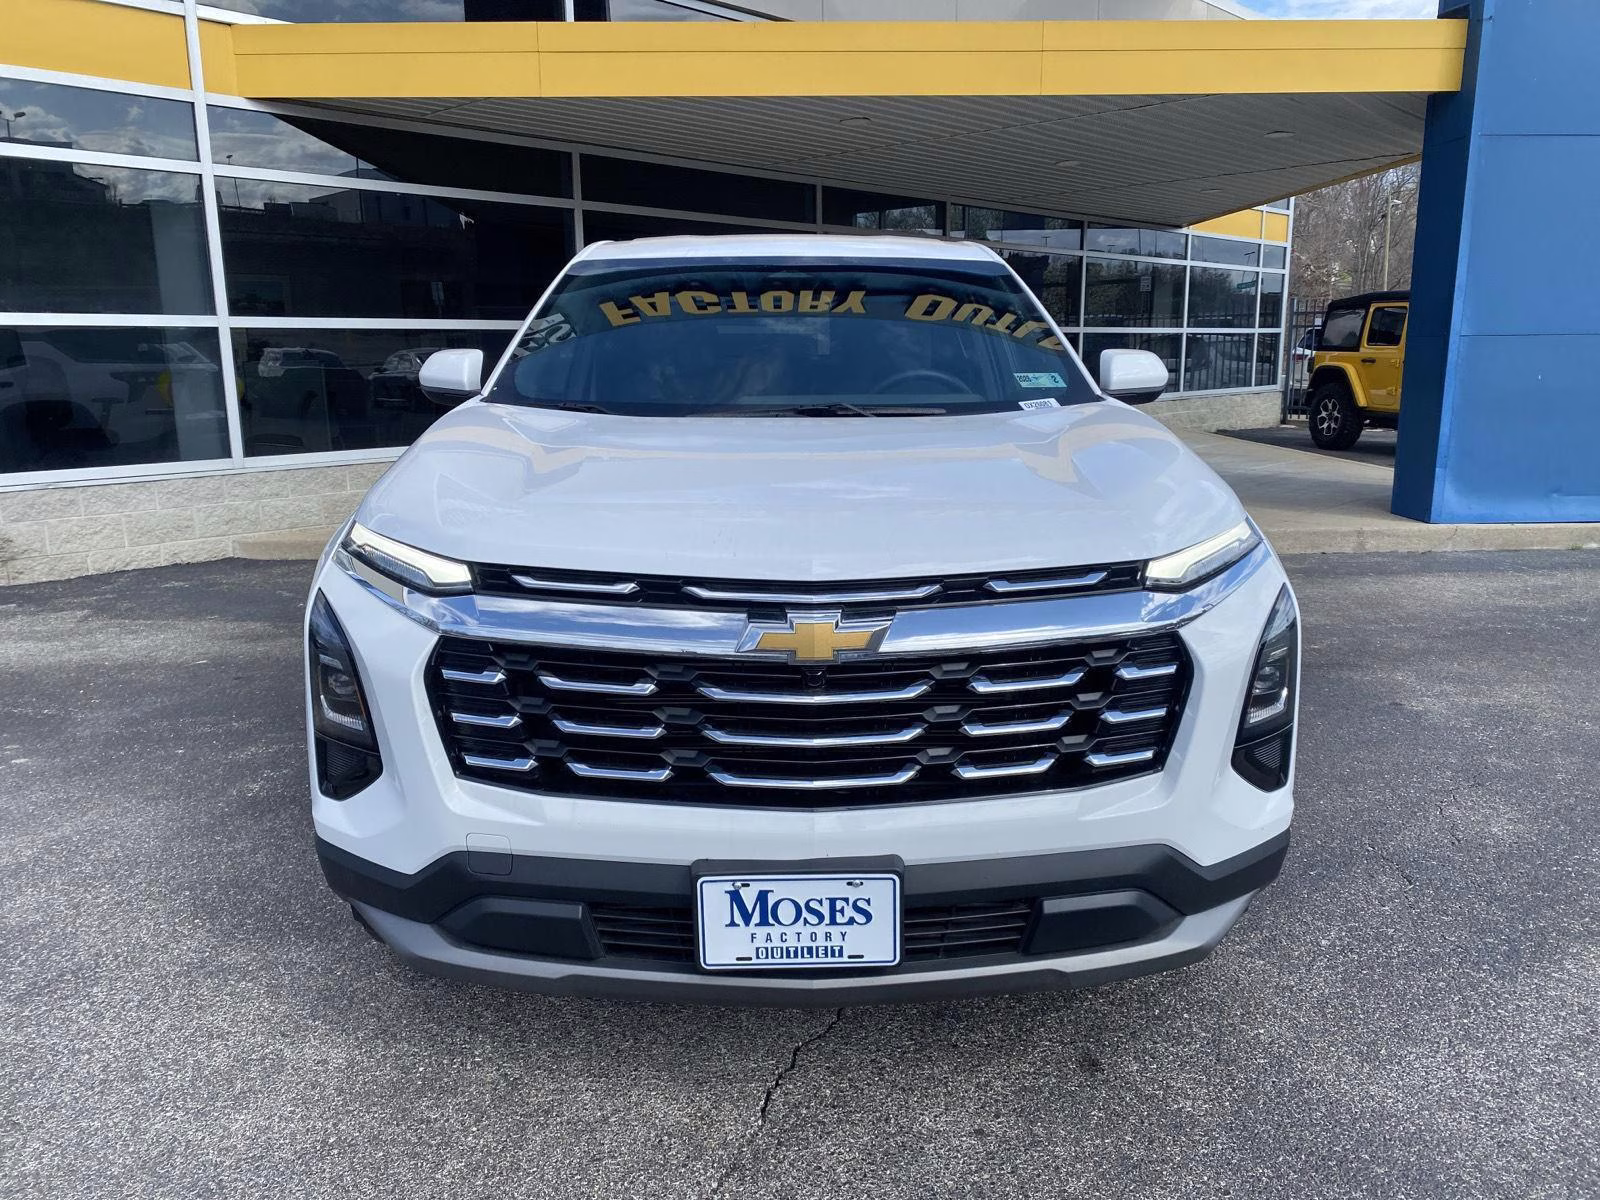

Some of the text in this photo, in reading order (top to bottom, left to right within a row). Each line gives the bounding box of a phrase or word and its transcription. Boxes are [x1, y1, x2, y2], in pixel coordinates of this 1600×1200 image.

[724, 889, 873, 928] MOSES
[750, 931, 848, 944] FACTORY
[757, 946, 844, 960] OUTLET
